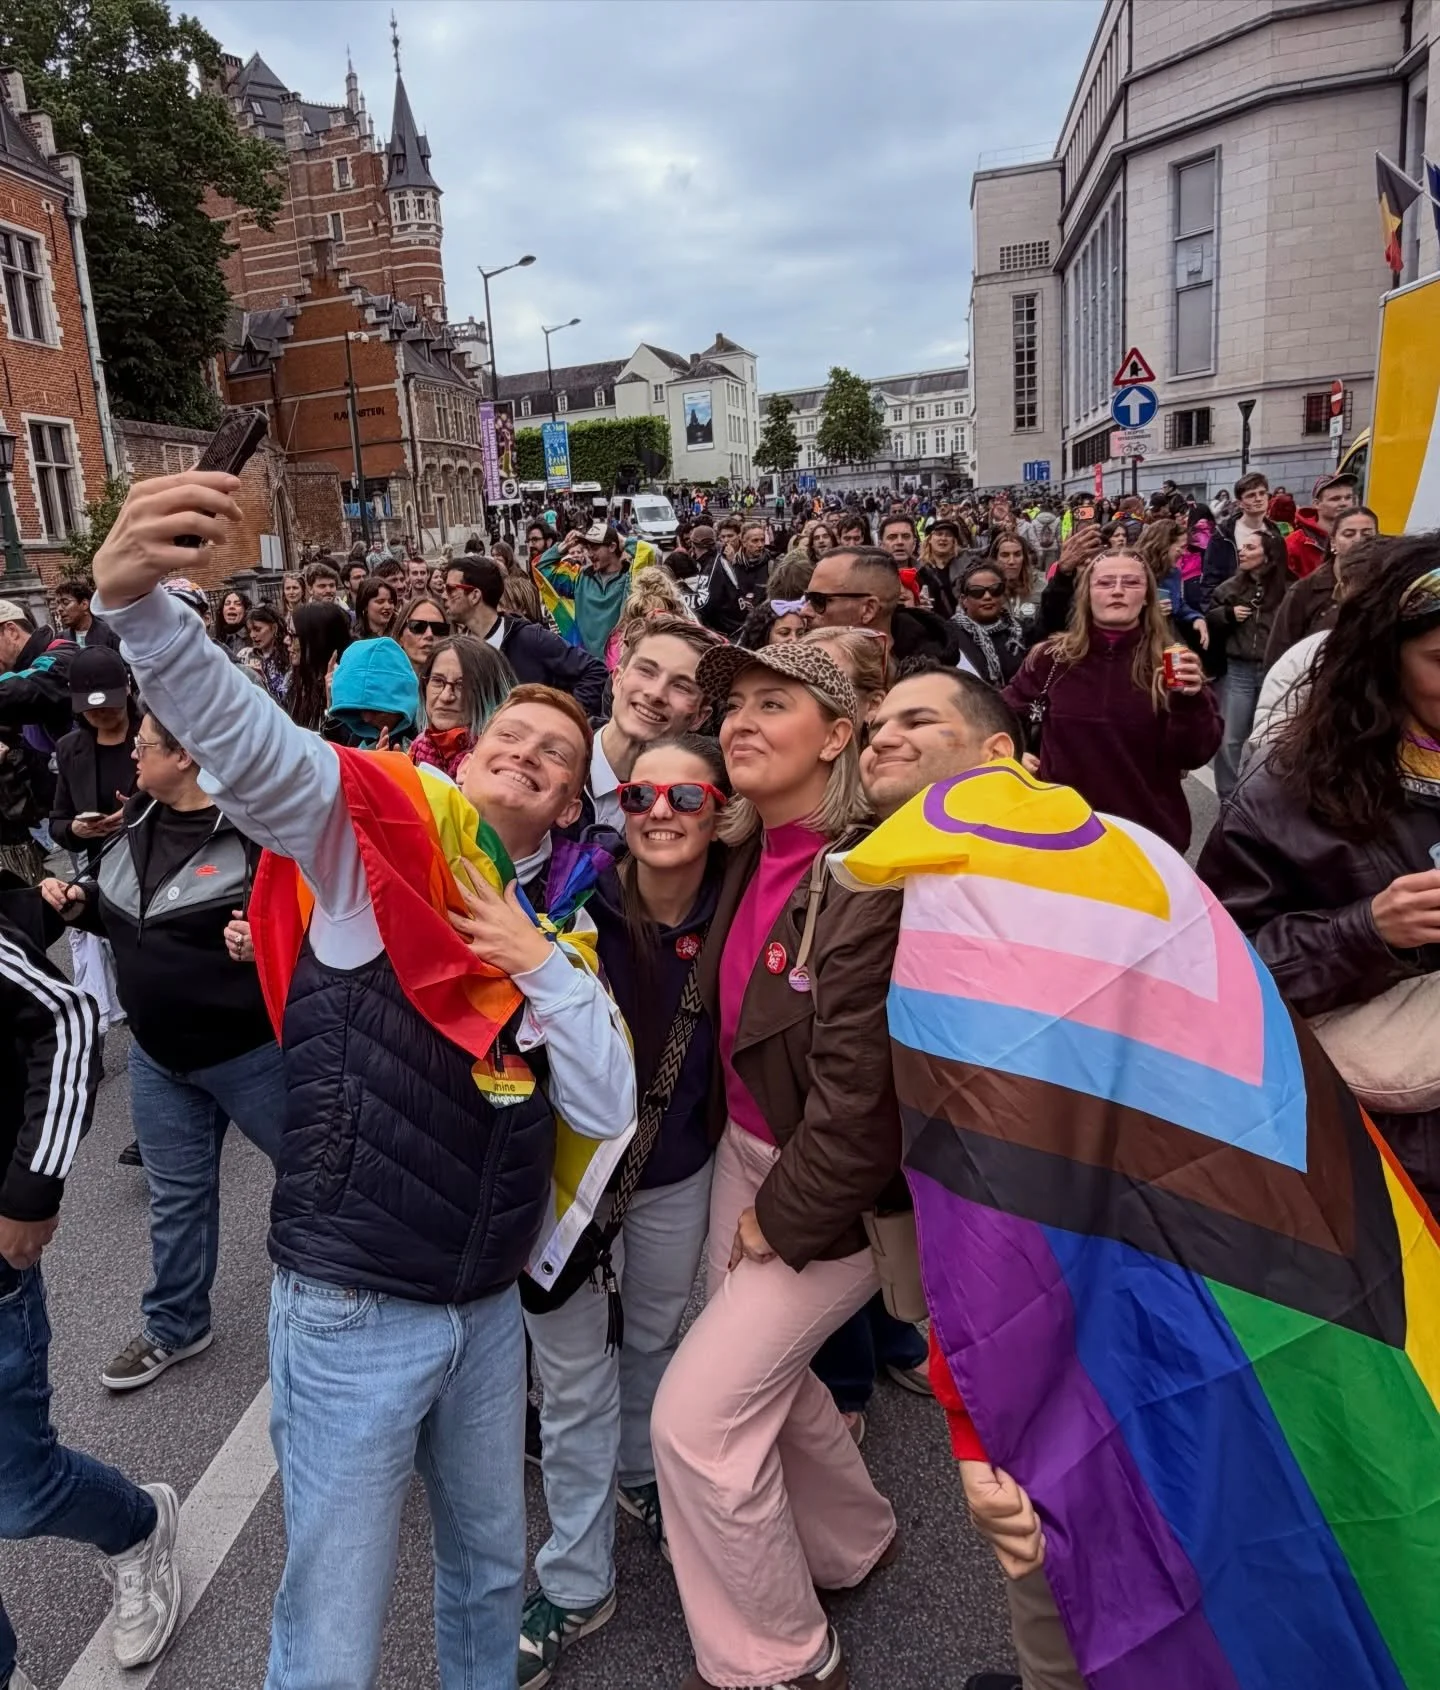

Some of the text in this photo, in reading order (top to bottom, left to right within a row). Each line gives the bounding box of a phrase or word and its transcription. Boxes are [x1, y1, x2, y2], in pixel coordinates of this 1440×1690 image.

[333, 407, 385, 421] RAVNSTEIN
[488, 418, 500, 499] WE SHINE BRIGHTER
[489, 1093, 524, 1105] brighter
